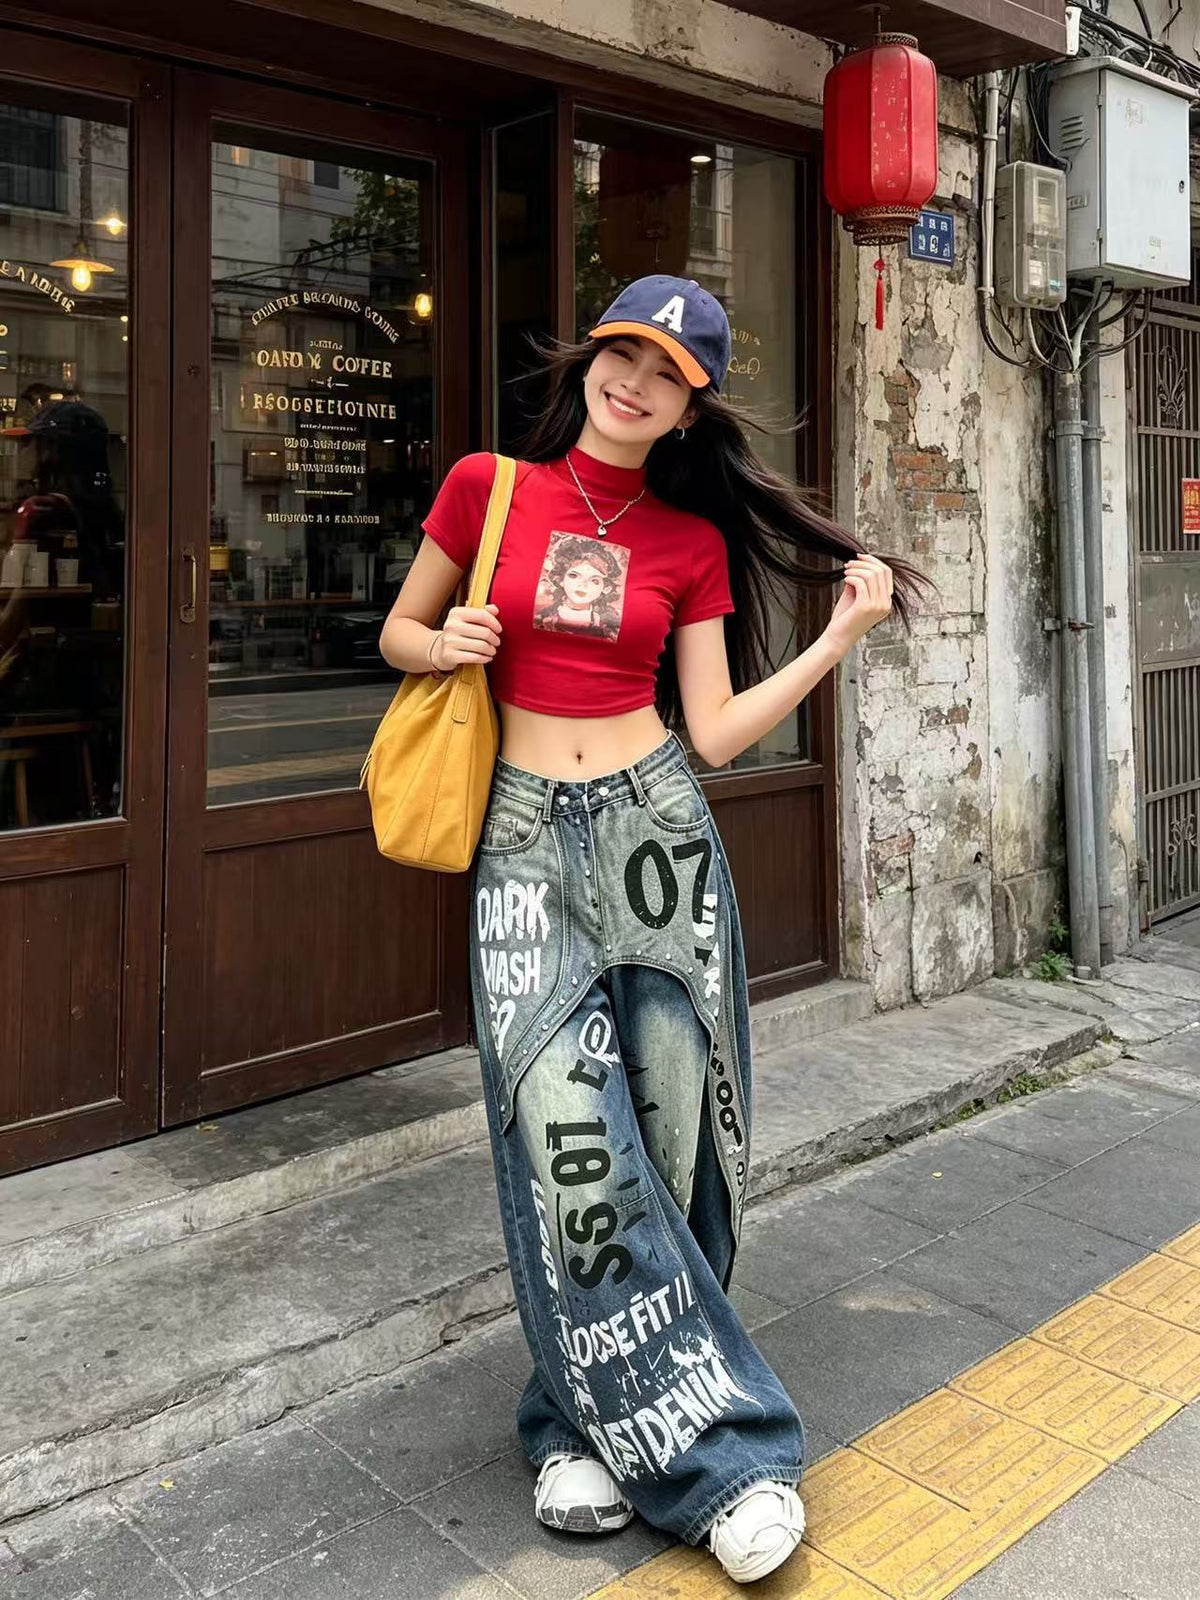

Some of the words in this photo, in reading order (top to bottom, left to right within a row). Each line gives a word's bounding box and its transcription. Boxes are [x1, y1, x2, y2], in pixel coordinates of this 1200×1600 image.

[651, 295, 685, 334] A
[477, 879, 550, 943] DARK
[624, 838, 713, 931] 07
[480, 946, 542, 997] WASH
[632, 1355, 742, 1475] DENIM
